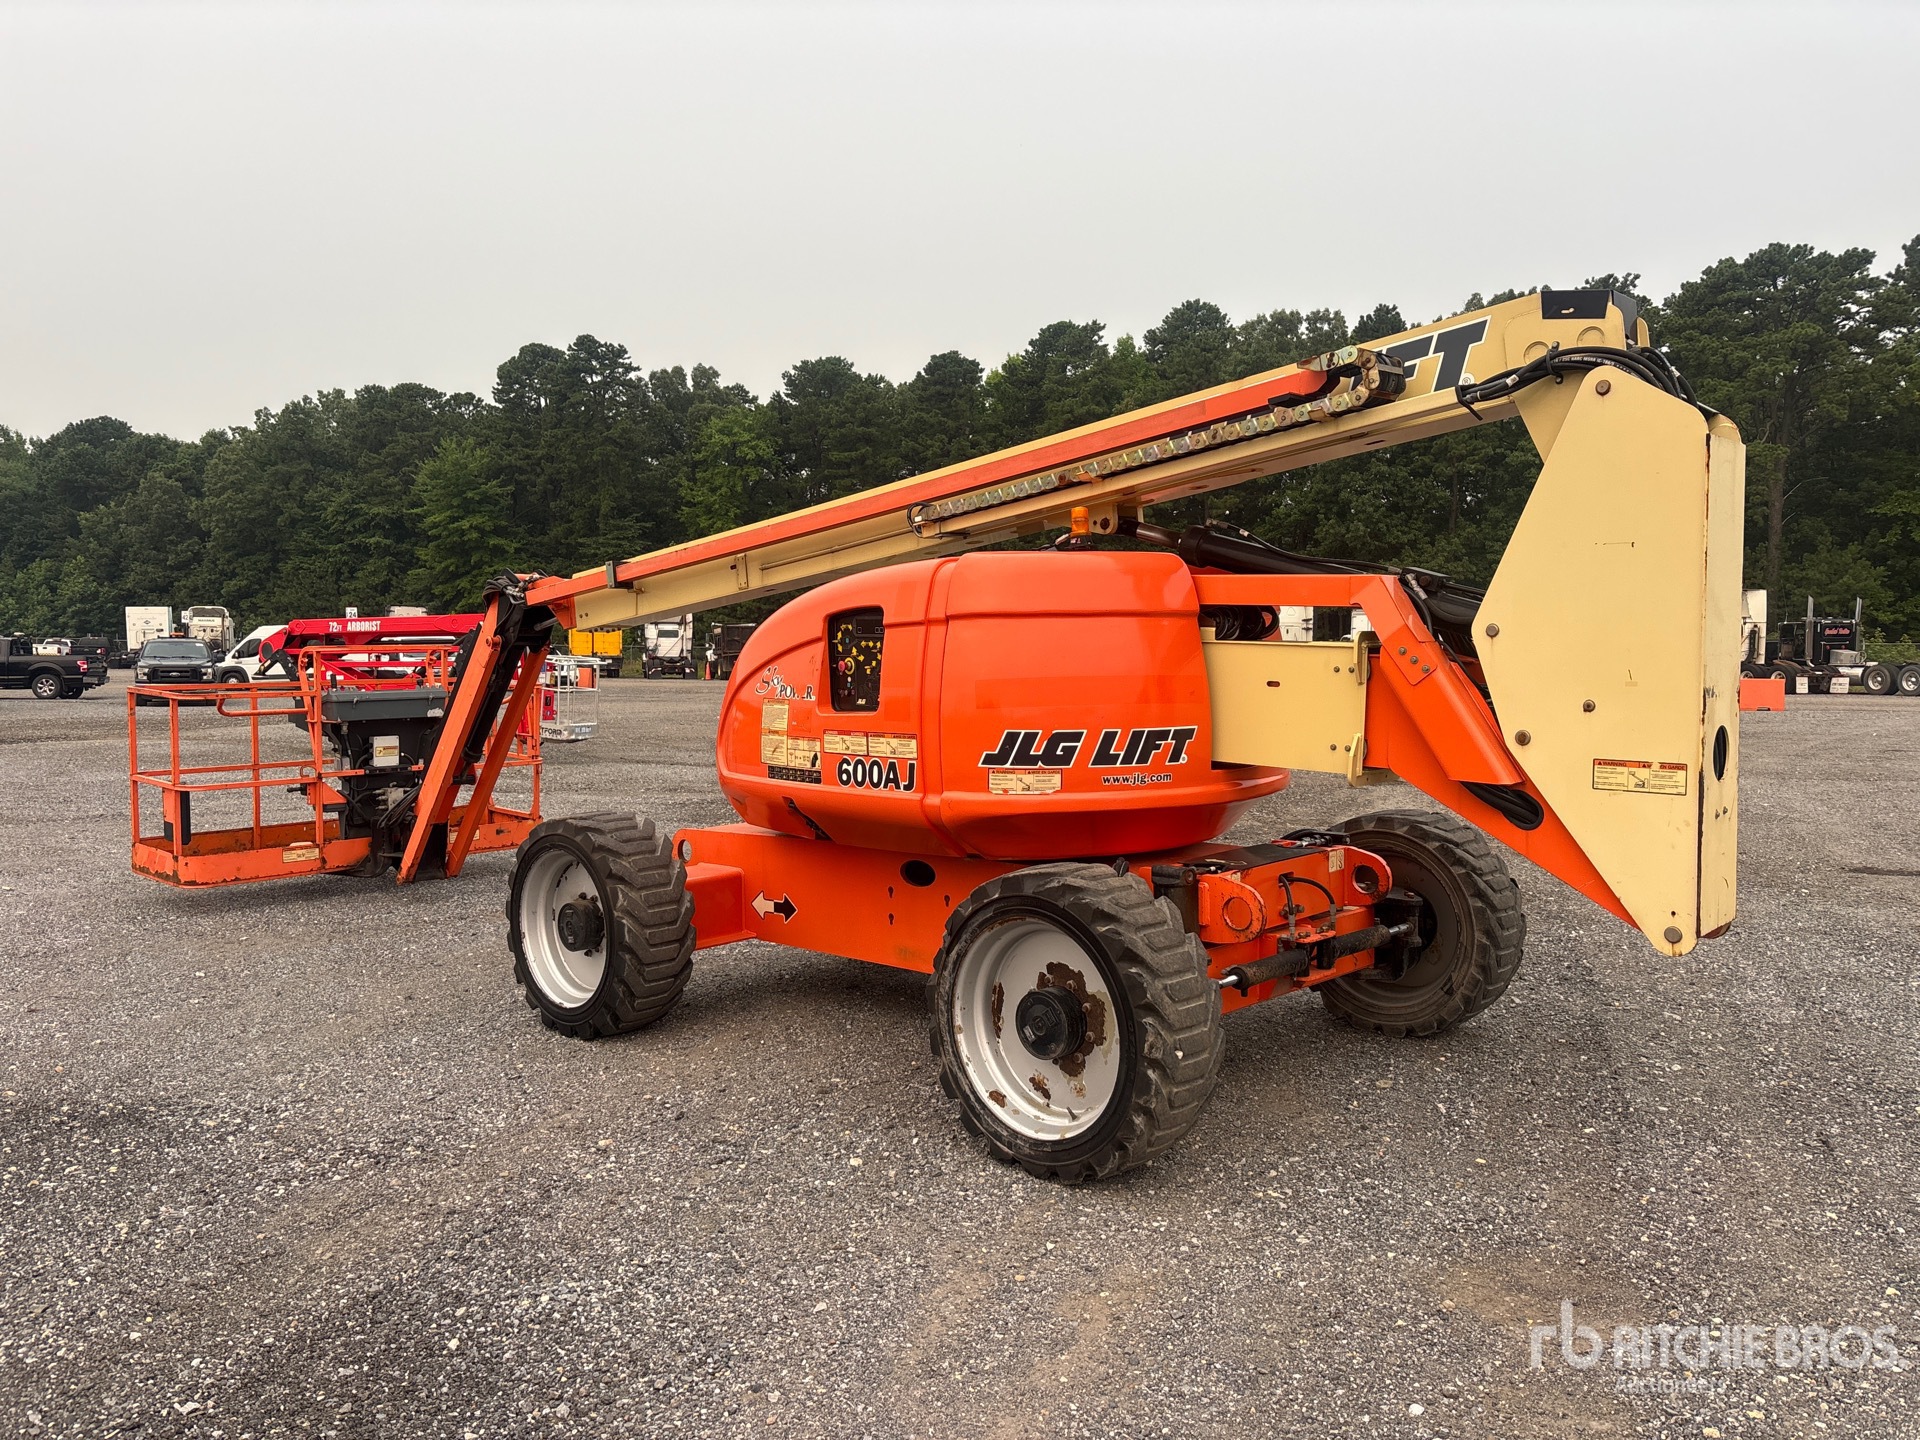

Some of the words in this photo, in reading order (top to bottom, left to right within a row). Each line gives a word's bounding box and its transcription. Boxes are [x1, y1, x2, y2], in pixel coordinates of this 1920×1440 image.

[1374, 315, 1491, 393] FT
[347, 620, 381, 632] ARBORIST
[978, 729, 1087, 768] JLG
[1088, 725, 1198, 768] LIFT
[837, 756, 917, 793] 600AJ
[1102, 772, 1172, 787] www.jlg.com
